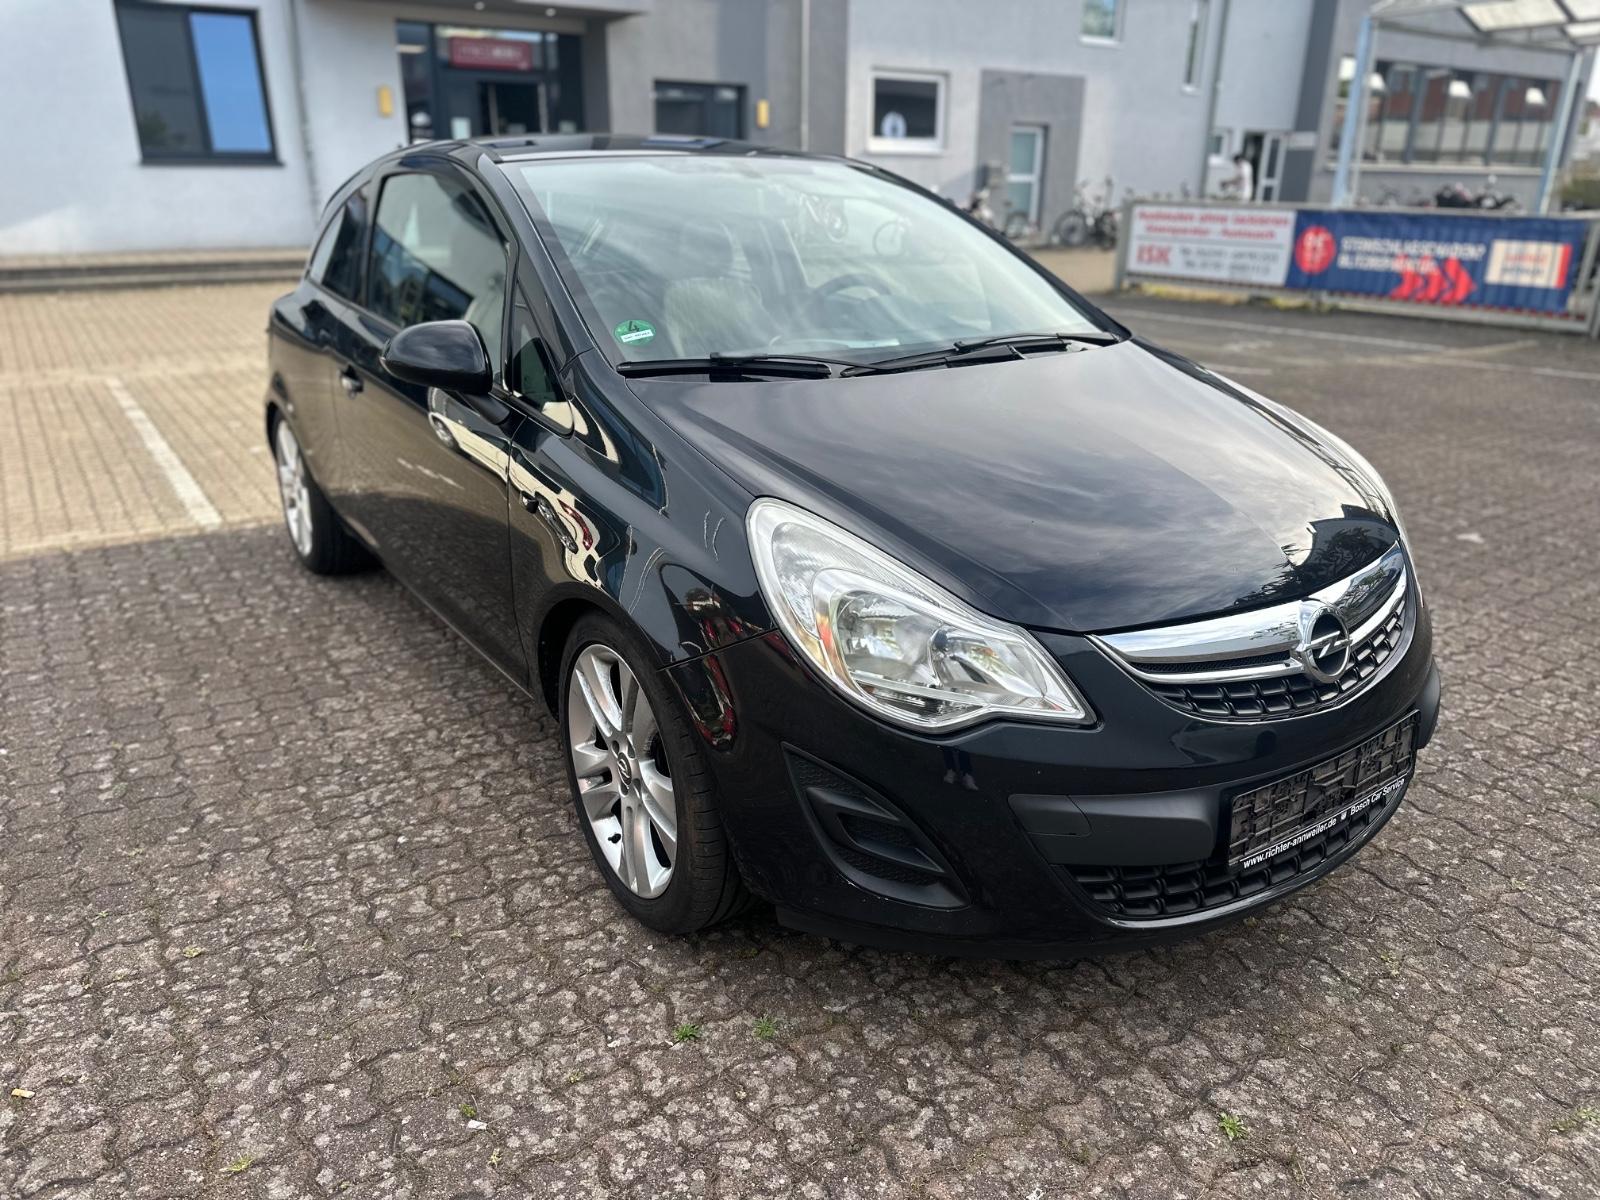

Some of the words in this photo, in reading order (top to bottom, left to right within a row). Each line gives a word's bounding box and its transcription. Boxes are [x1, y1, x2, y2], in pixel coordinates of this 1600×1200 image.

[1243, 818, 1337, 869] www.richter-annweiler.de
[1350, 798, 1370, 816] Bosch
[1371, 791, 1383, 803] Car
[1382, 778, 1405, 796] Service
